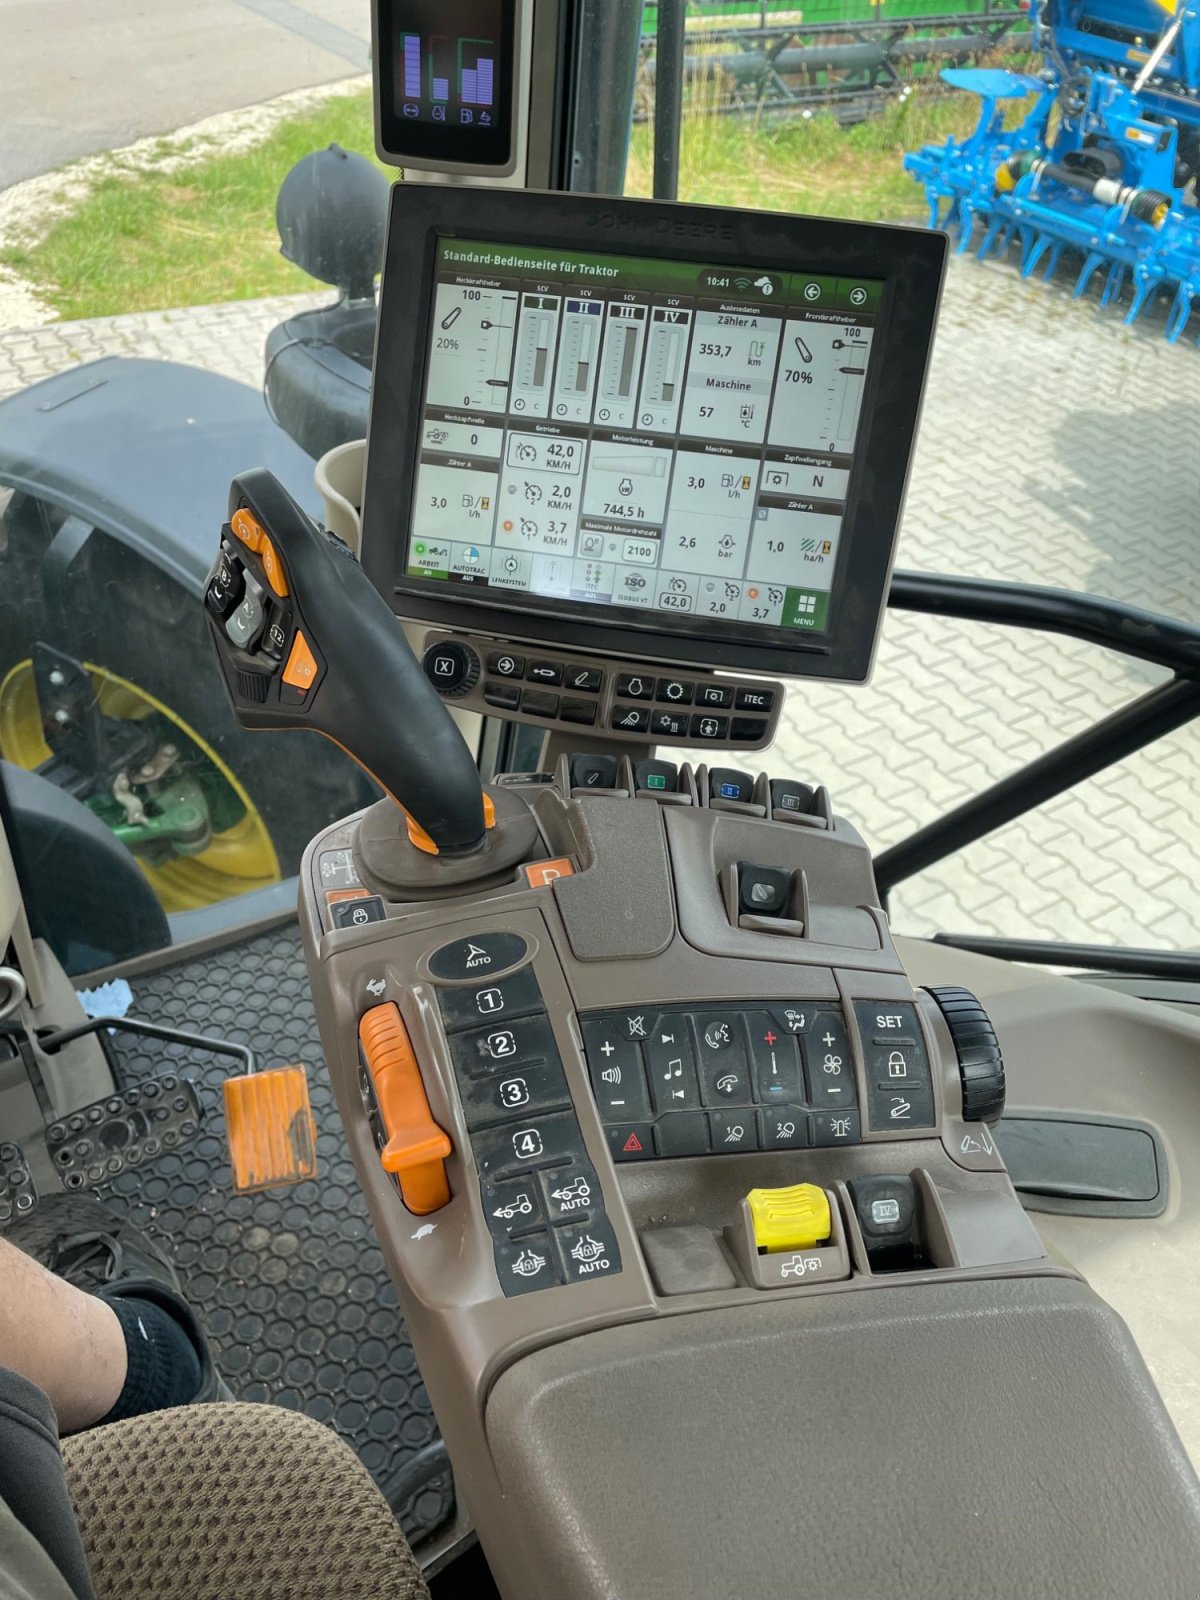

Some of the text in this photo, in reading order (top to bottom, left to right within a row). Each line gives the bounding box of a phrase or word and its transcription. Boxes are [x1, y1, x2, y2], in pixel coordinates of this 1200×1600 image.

[585, 210, 733, 240] JOHN DEERE
[443, 250, 619, 277] Standard-Bedienseite für Traktor
[456, 276, 501, 287] Heckkraftheber
[707, 276, 730, 287] 10:41
[462, 289, 481, 300] 100
[538, 298, 544, 309] I
[579, 302, 589, 313] II
[720, 304, 760, 314] Auslesedaten
[619, 306, 635, 318] III
[663, 311, 680, 323] IV
[805, 312, 857, 324] Frontkraftheber
[717, 316, 758, 328] Zähler A
[844, 328, 861, 337] 100
[436, 337, 459, 350] 20%
[699, 344, 732, 358] 353,7
[747, 358, 761, 367] km
[784, 370, 813, 384] 70%
[706, 378, 752, 391] Maschine
[464, 396, 470, 405] 0
[699, 407, 714, 418] 57
[444, 414, 485, 425] Heckzapfwelle
[535, 425, 560, 433] Getriebe
[470, 434, 478, 445] 0
[612, 434, 654, 446] Motorleistung
[547, 444, 574, 458] 42,0
[705, 445, 733, 454] Maschine
[829, 443, 835, 452] 0
[448, 458, 466, 467] Zähler
[546, 460, 571, 470] KM/H
[784, 454, 832, 466] Zapfwellengang
[687, 477, 705, 489] 3,0
[812, 475, 824, 487] N
[552, 485, 571, 498] 2,0
[728, 490, 740, 499] l/h
[430, 497, 447, 508] 3,0
[547, 500, 572, 510] KM/H
[788, 501, 807, 510] Zähler
[469, 510, 480, 518] l/h
[603, 503, 645, 518] 744,5 h
[548, 521, 567, 534] 3,7
[585, 522, 657, 536] Maximale Motordrehzahl
[543, 535, 568, 545] KM/H
[679, 536, 696, 548] 2,6
[628, 546, 651, 556] 2100
[767, 541, 784, 553] 1,0
[718, 549, 733, 559] bar
[804, 554, 824, 563] ha/h
[452, 564, 485, 575] AUTOTRAC
[491, 577, 526, 587] LENKSYSTEM
[624, 576, 646, 588] ISO
[663, 596, 687, 608] 42,0
[710, 602, 726, 613] 2,0
[752, 608, 769, 619] 3,7
[541, 868, 561, 884] P
[466, 956, 492, 968] AUTO
[485, 994, 495, 1008] 1
[876, 1015, 902, 1028] SET
[495, 1037, 508, 1052] 2
[508, 1085, 521, 1100] 3
[521, 1136, 535, 1152] 4
[560, 1197, 591, 1212] AUTO
[879, 1206, 892, 1216] IV
[578, 1259, 610, 1275] AUTO
